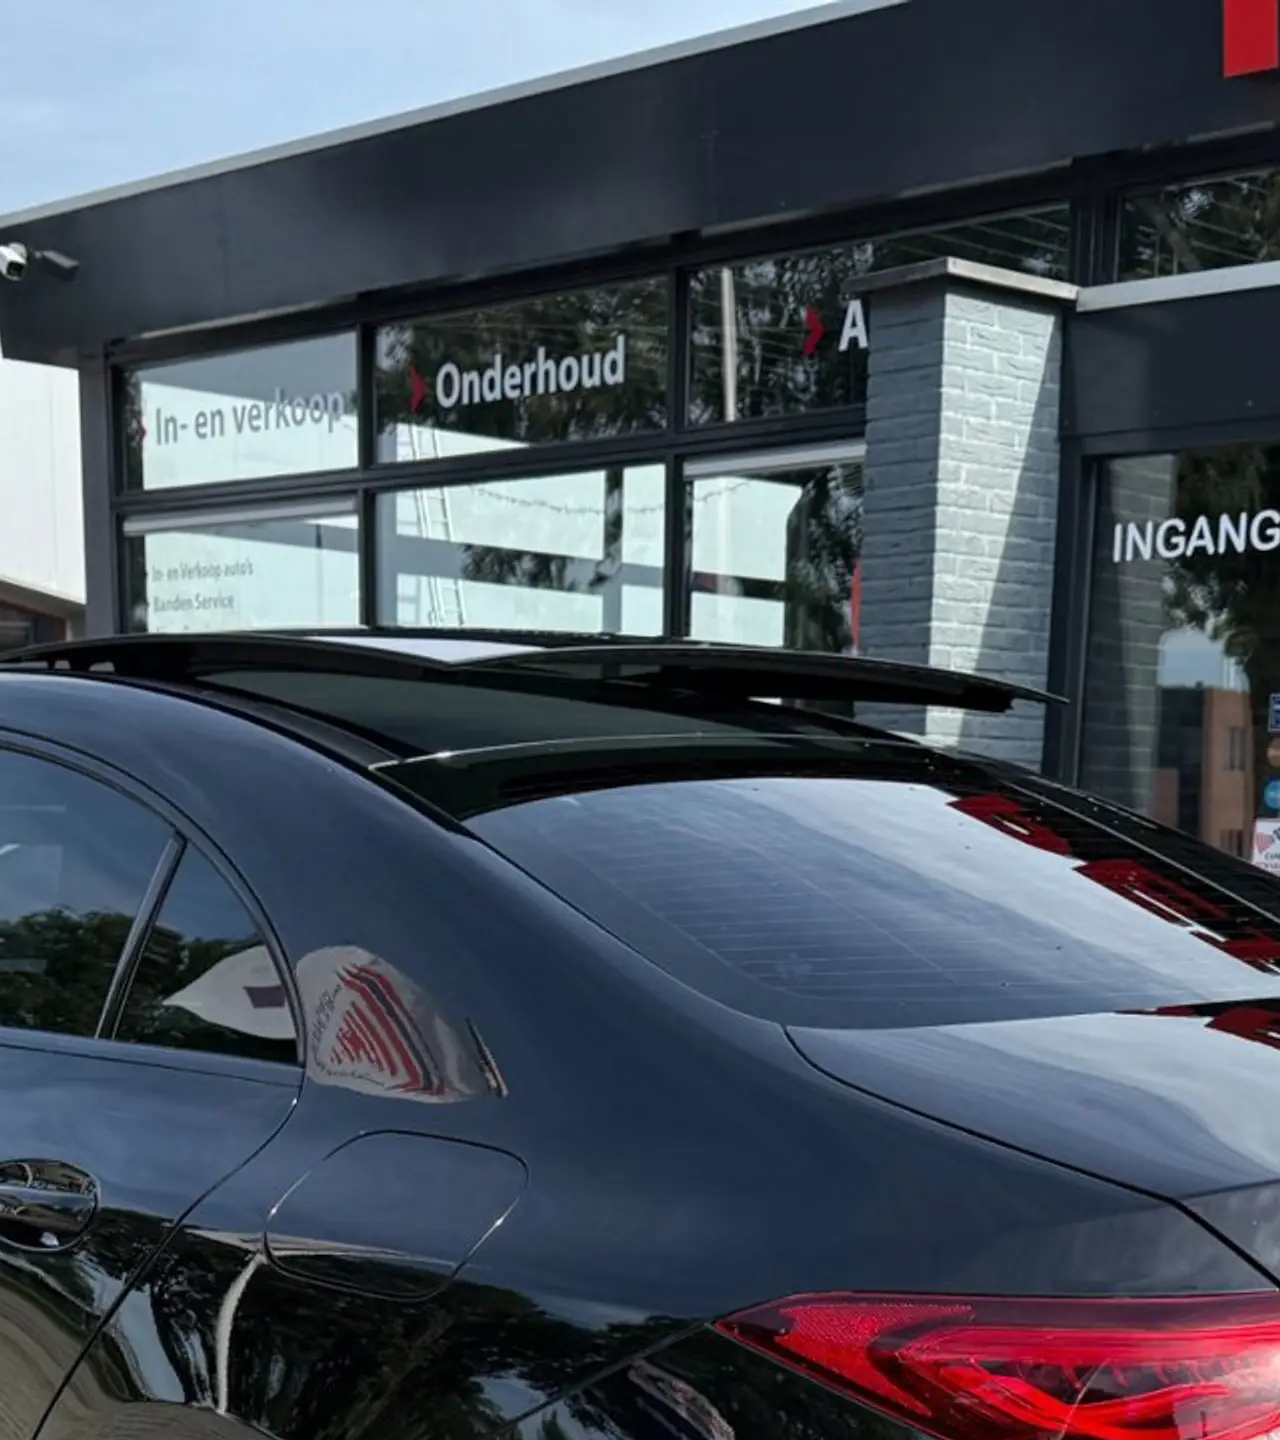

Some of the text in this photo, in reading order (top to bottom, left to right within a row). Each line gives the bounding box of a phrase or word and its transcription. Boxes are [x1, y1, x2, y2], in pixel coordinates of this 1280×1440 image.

[436, 334, 625, 408] Onderhoud
[155, 386, 346, 446] In- en verkoop
[195, 591, 235, 610] Service
